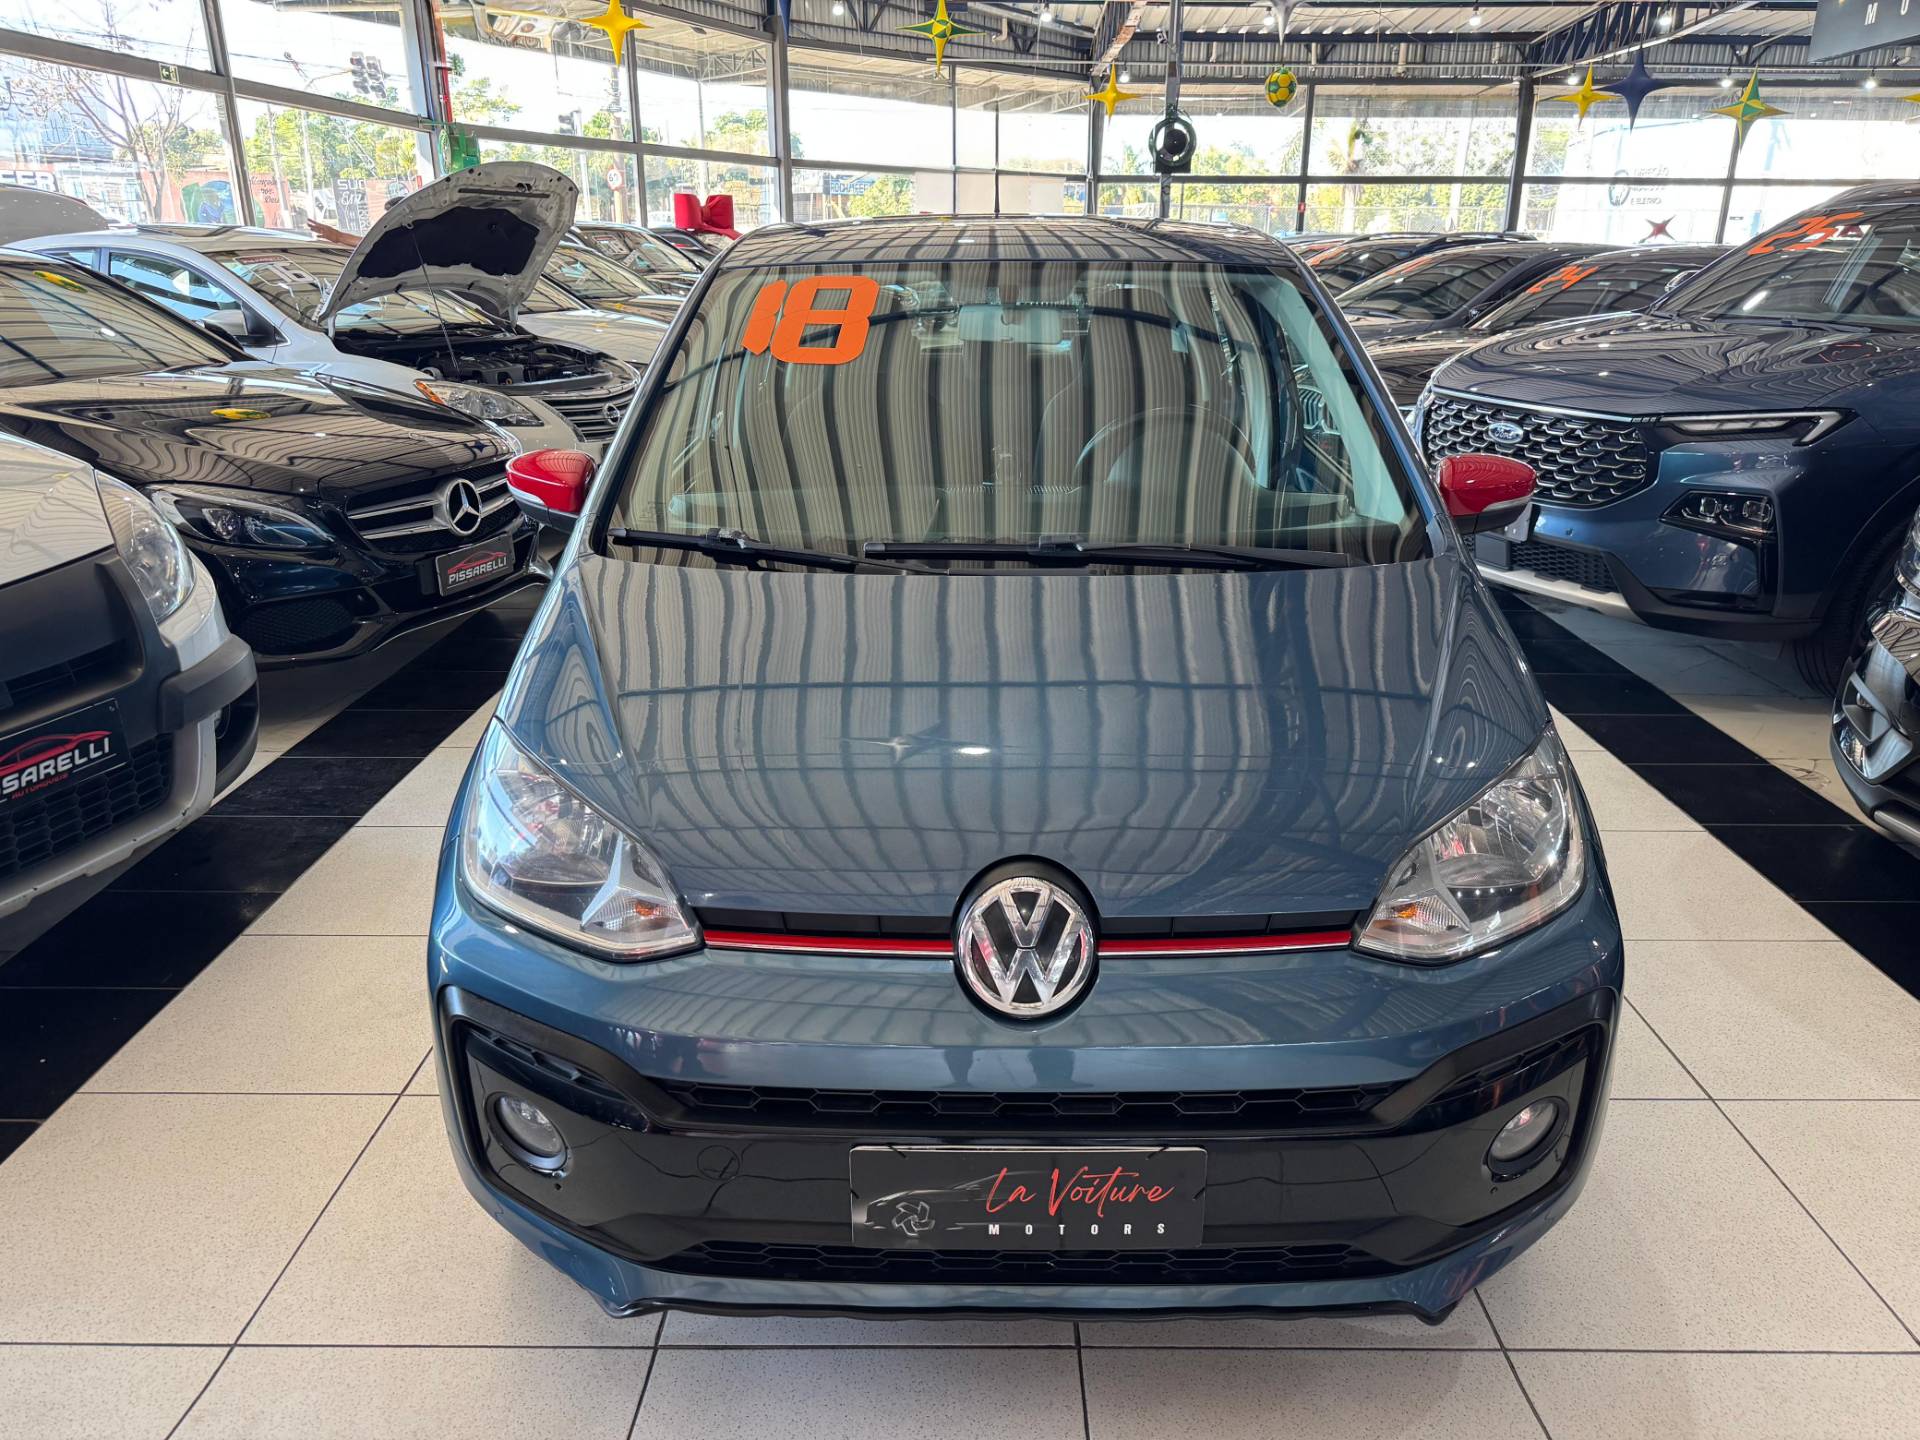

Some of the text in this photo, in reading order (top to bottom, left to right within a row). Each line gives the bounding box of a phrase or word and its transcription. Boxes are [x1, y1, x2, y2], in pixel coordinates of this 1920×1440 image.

[1748, 211, 1864, 256] 25
[741, 275, 880, 365] 18
[448, 556, 508, 585] PISSARELLI
[0, 737, 110, 795] SARELLI
[964, 882, 1089, 1010] VW
[985, 1166, 1175, 1217] La Voiture
[988, 1223, 1165, 1235] MOTORS
